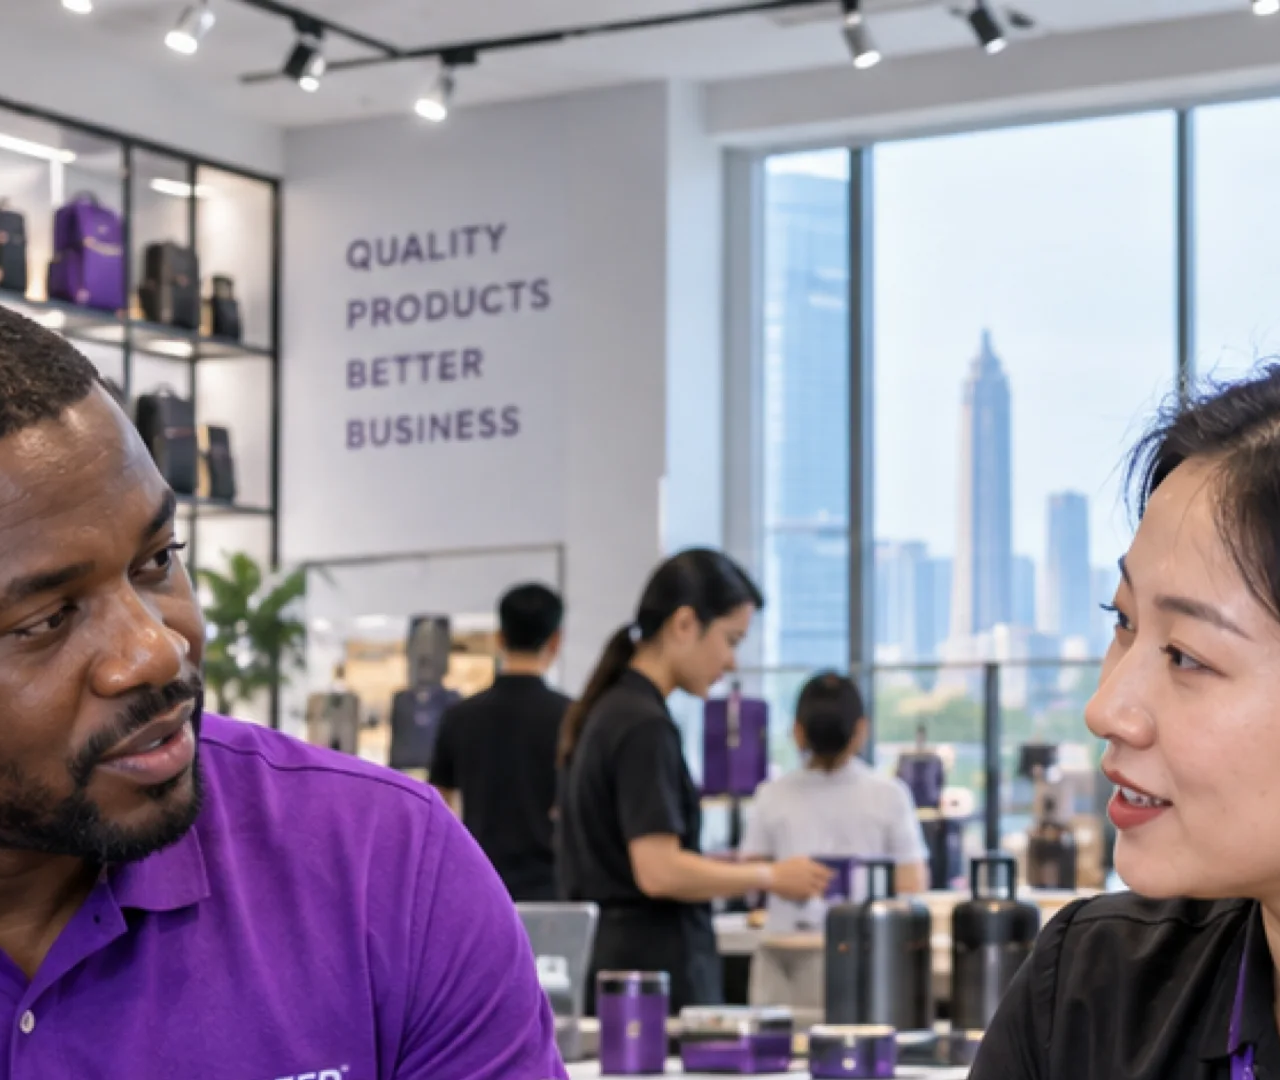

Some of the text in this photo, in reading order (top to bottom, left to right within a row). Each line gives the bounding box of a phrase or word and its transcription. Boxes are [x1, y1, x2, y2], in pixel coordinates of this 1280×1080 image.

[345, 221, 507, 271] QUALITY
[345, 277, 551, 330] PRODUCTS
[345, 347, 485, 390] BETTER
[345, 404, 521, 450] BUSINESS
